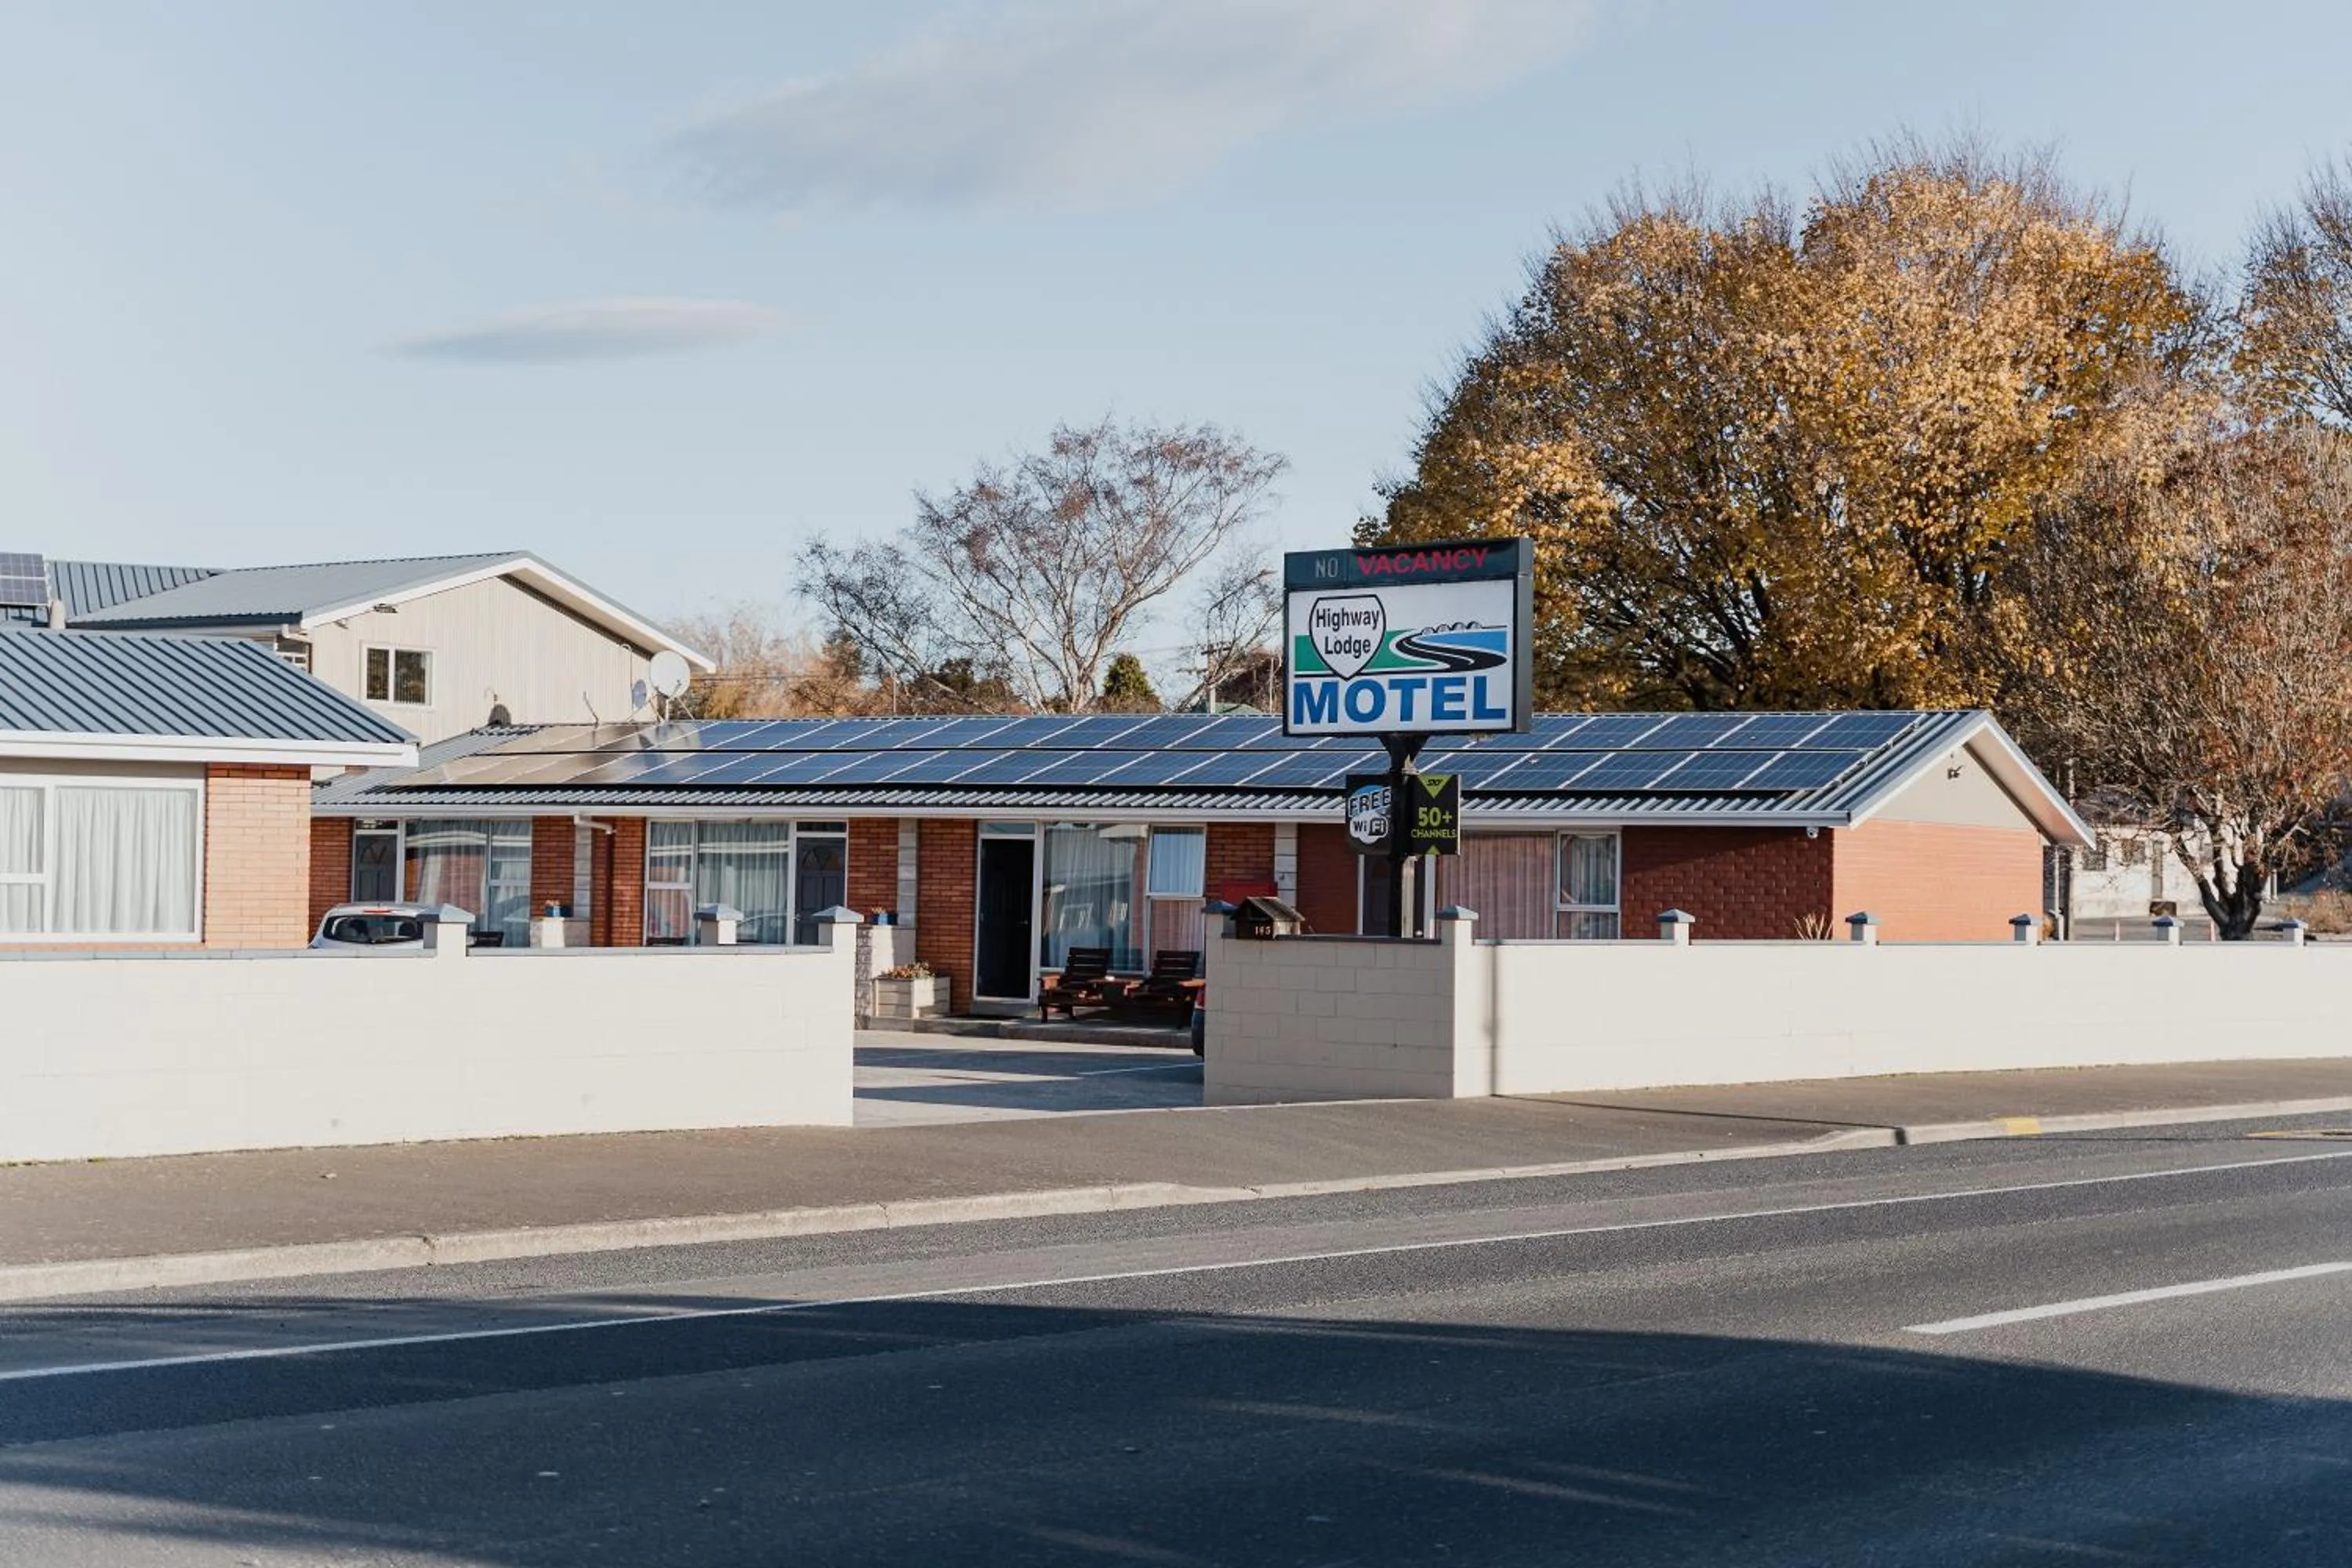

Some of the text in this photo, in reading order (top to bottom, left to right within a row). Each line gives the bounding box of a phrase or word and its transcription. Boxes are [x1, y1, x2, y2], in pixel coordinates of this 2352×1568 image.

[1315, 549, 1487, 578] NO VACANCY
[1316, 608, 1380, 630] Highway
[1324, 635, 1371, 659] Lodge
[1294, 676, 1506, 725] MOTEL
[1348, 787, 1391, 816] FREE
[1418, 807, 1452, 827] 50+
[1411, 829, 1457, 838] CHANNELS
